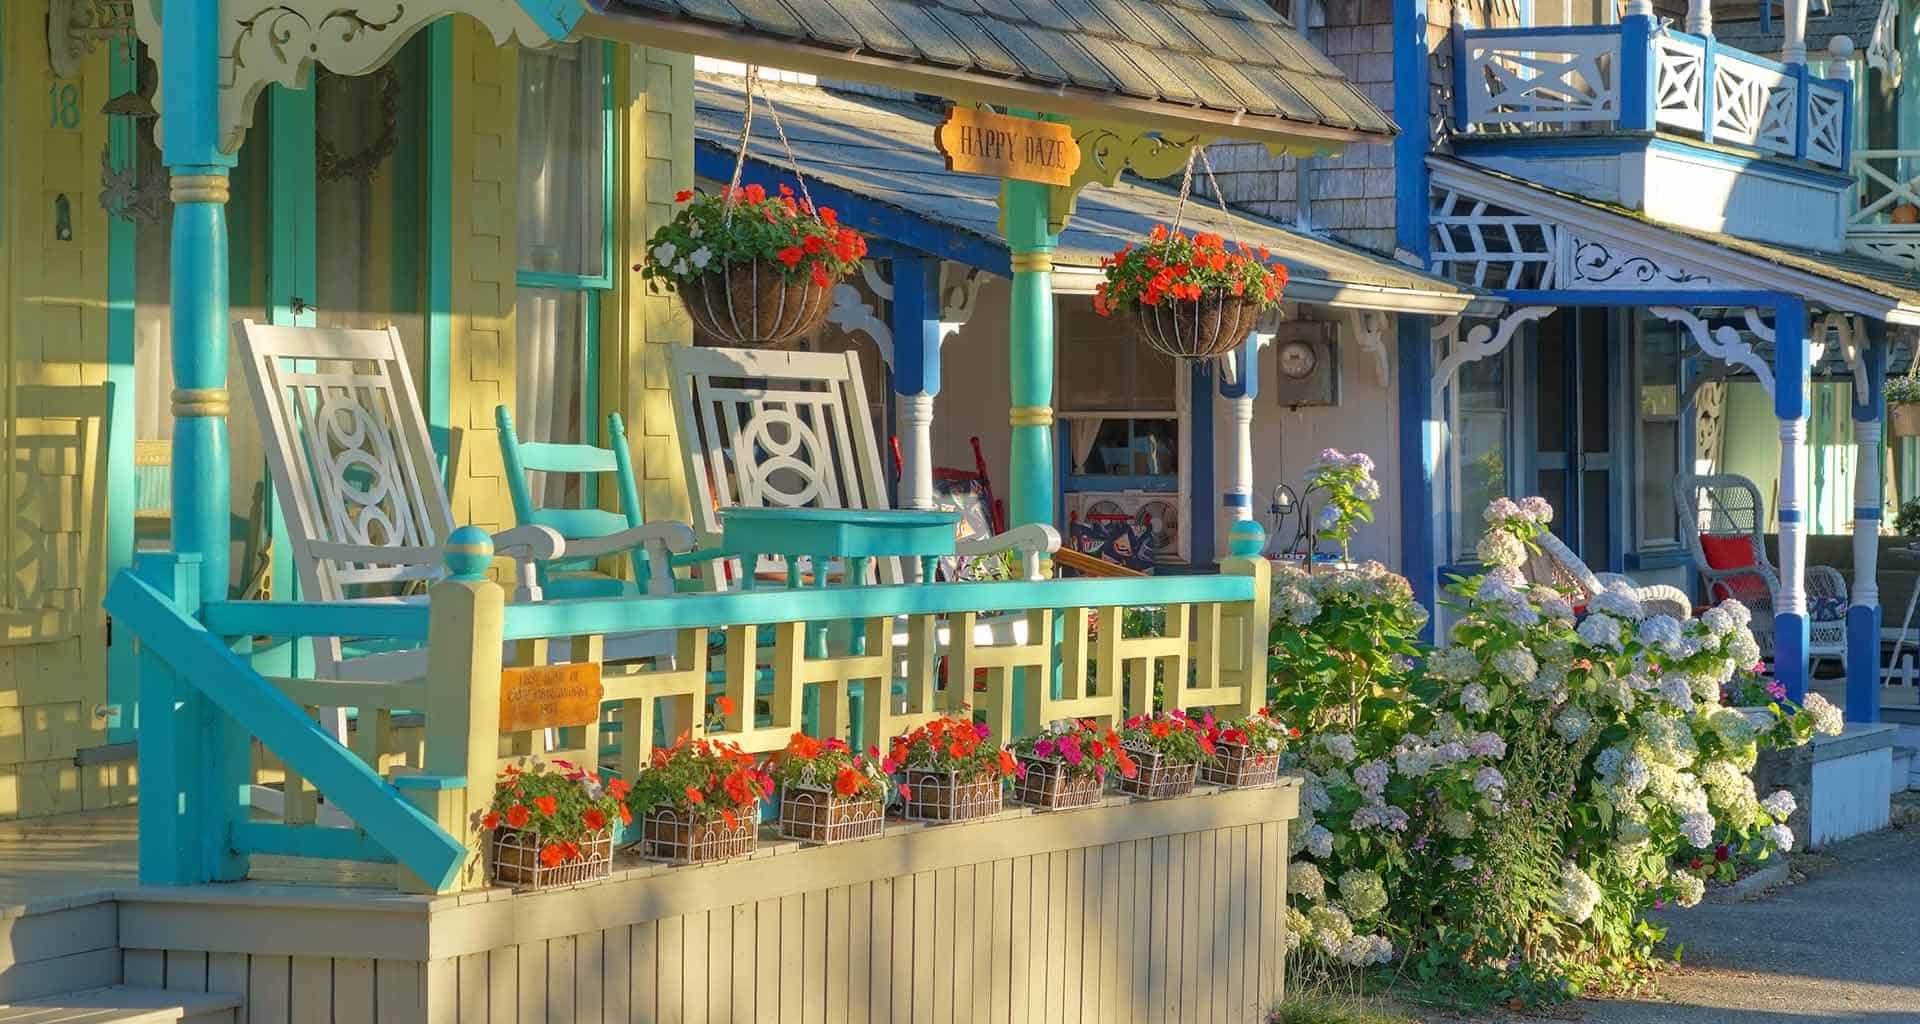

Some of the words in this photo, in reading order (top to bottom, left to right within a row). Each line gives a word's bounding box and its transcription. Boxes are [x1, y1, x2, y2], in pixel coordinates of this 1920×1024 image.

[49, 83, 81, 129] 18
[960, 125, 1017, 162] HAPPY
[1024, 136, 1066, 169] DAZE
